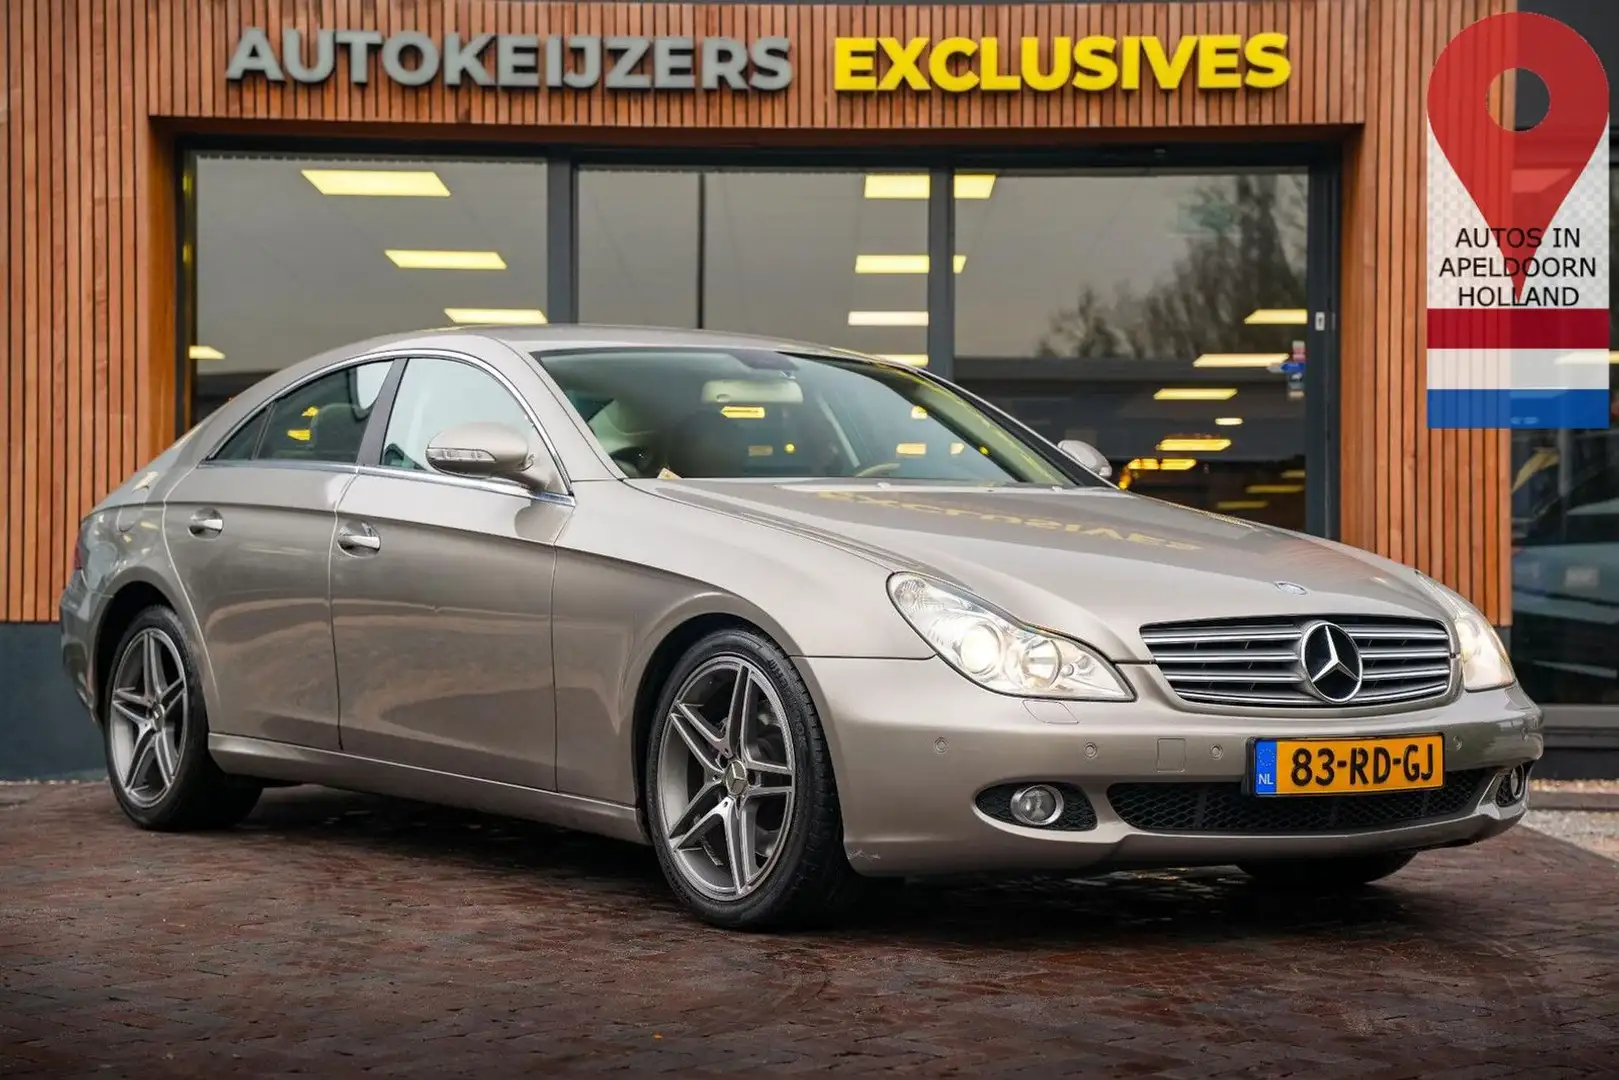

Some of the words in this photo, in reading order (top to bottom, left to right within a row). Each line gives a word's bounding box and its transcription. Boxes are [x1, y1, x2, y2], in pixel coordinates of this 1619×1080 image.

[226, 27, 793, 91] AUTOKEIJZERS
[834, 33, 1291, 91] EXCLUSIVES
[1257, 773, 1274, 785] NL
[1291, 743, 1434, 787] 83-RD-GJ
